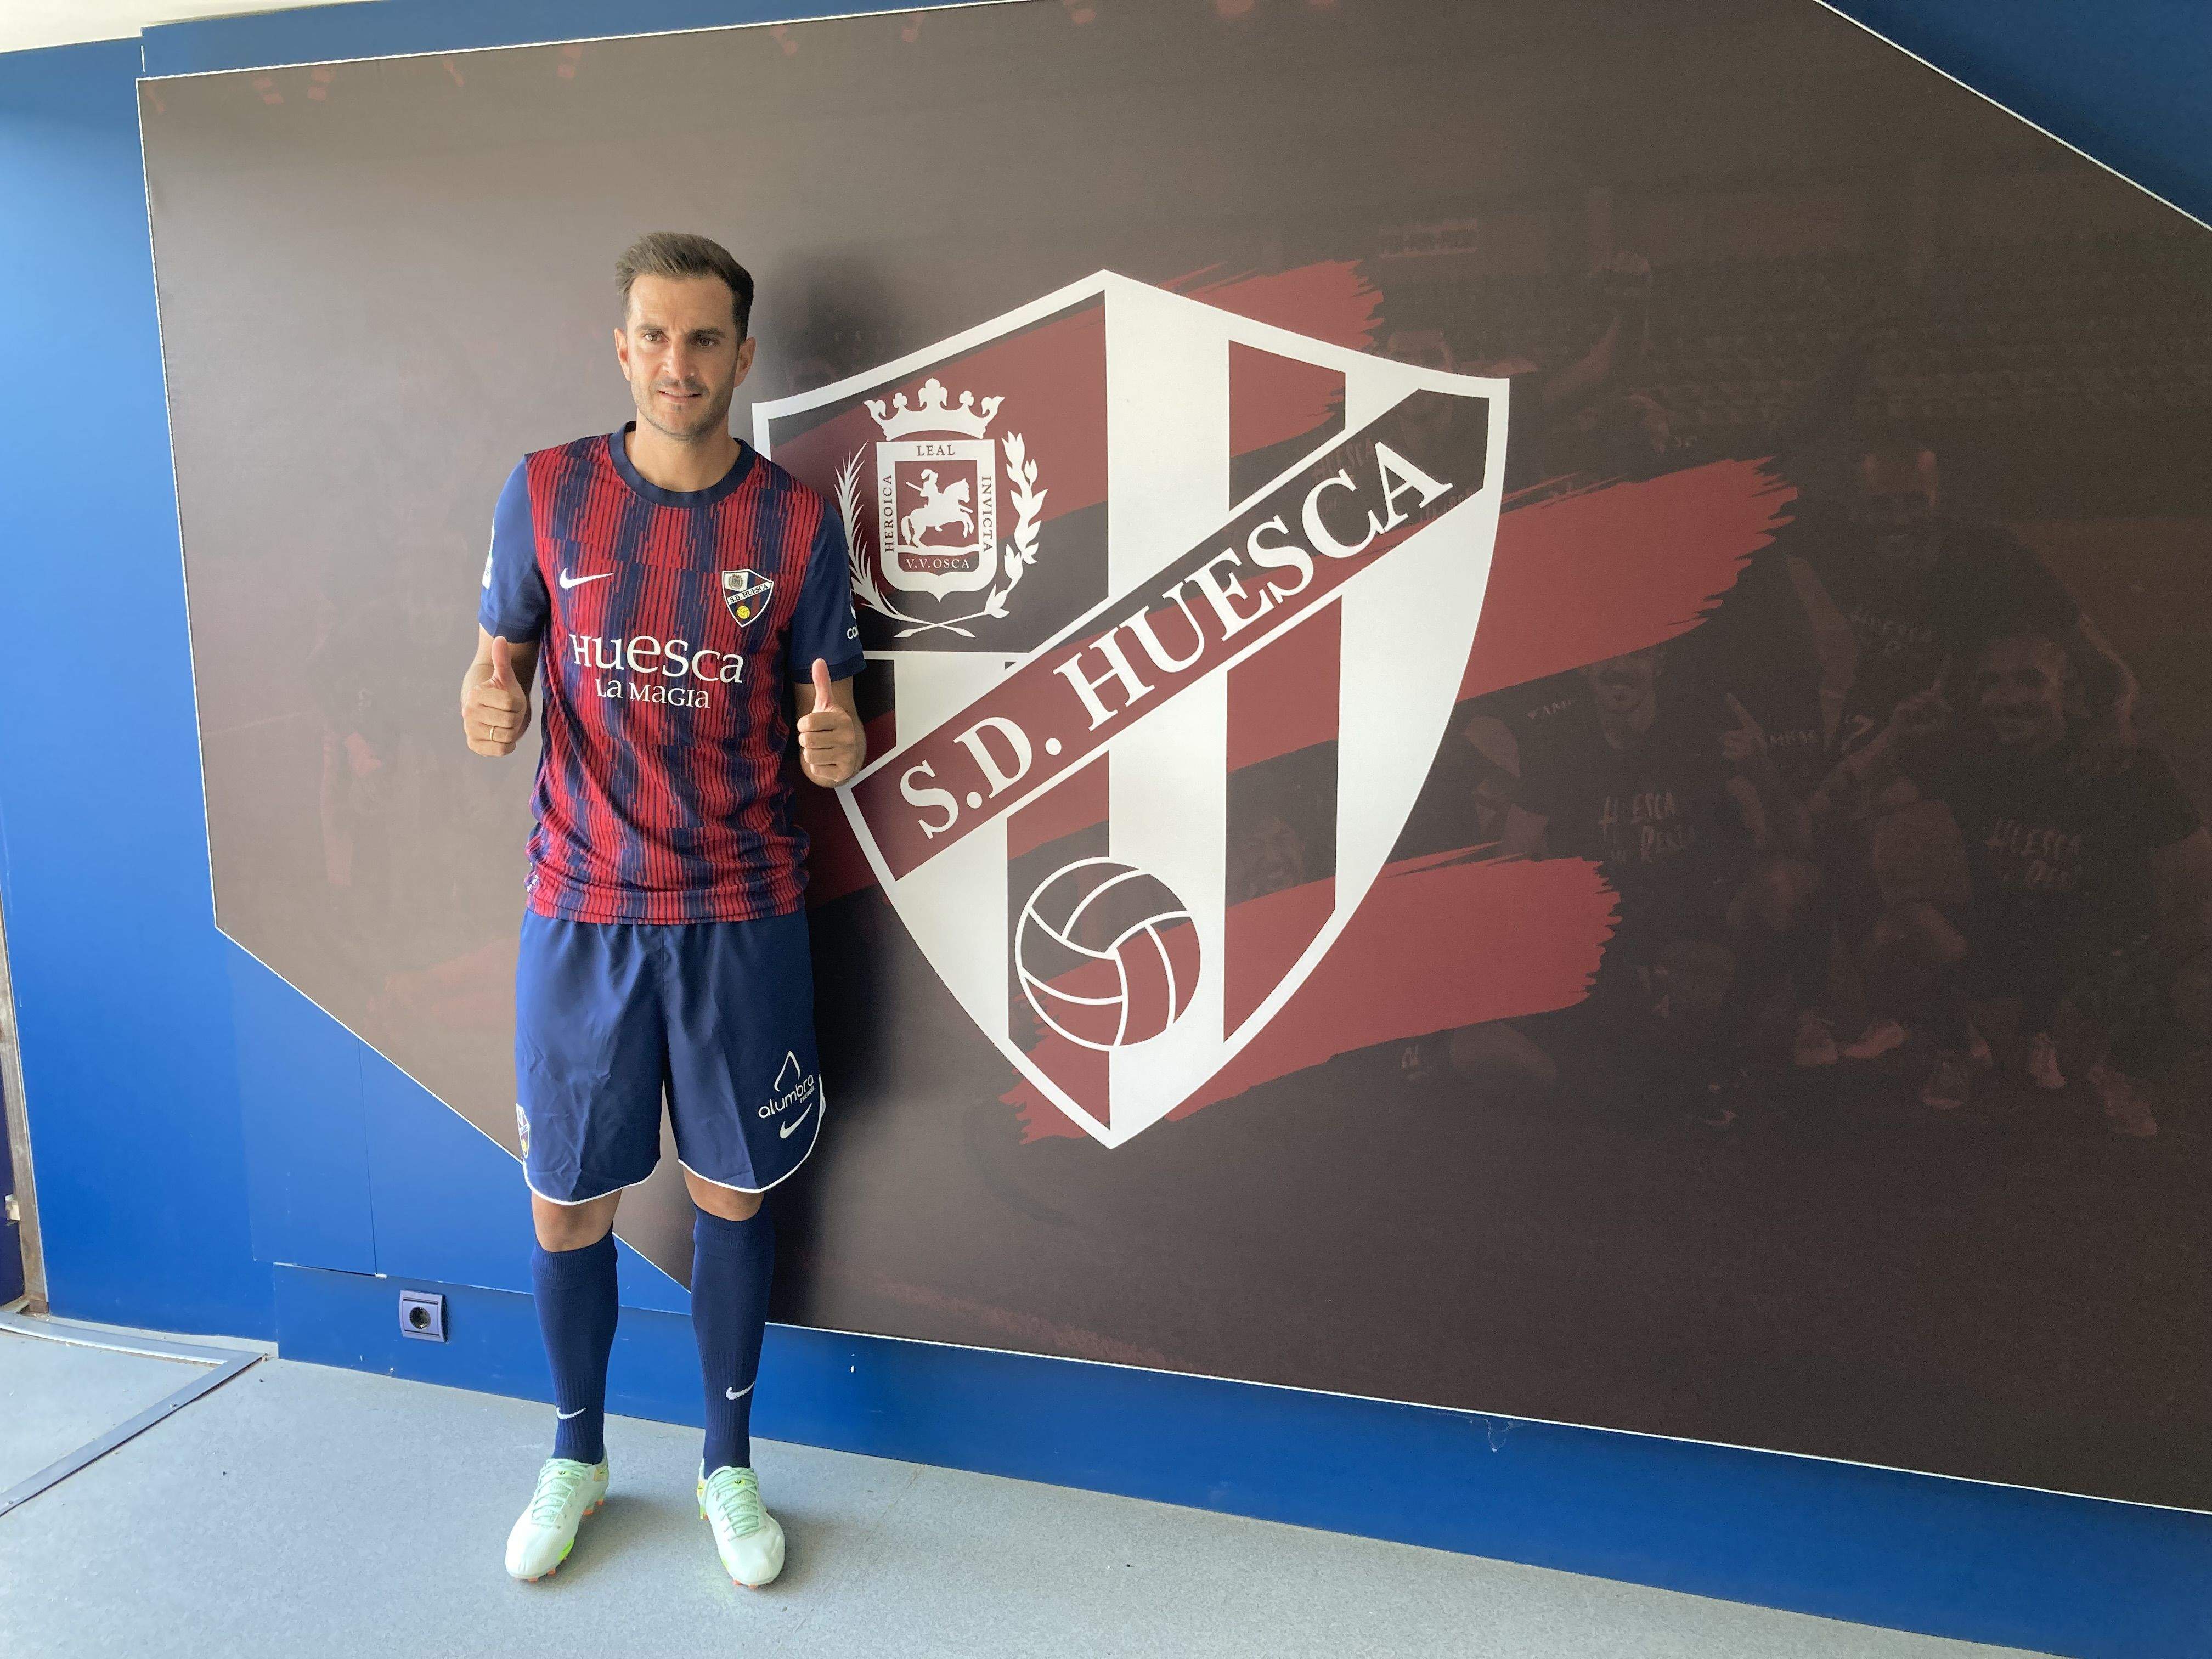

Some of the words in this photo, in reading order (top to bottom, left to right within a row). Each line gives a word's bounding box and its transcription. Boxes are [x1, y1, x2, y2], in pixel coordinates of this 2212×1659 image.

[917, 445, 955, 456] LEAL
[882, 475, 894, 552] HEROICA
[981, 476, 993, 552] INVICTA
[730, 595, 742, 603] S.D.
[743, 584, 769, 598] HUESCA
[569, 634, 744, 684] Huesca
[899, 716, 1063, 841] S.D.
[1052, 441, 1453, 732] HUESCA
